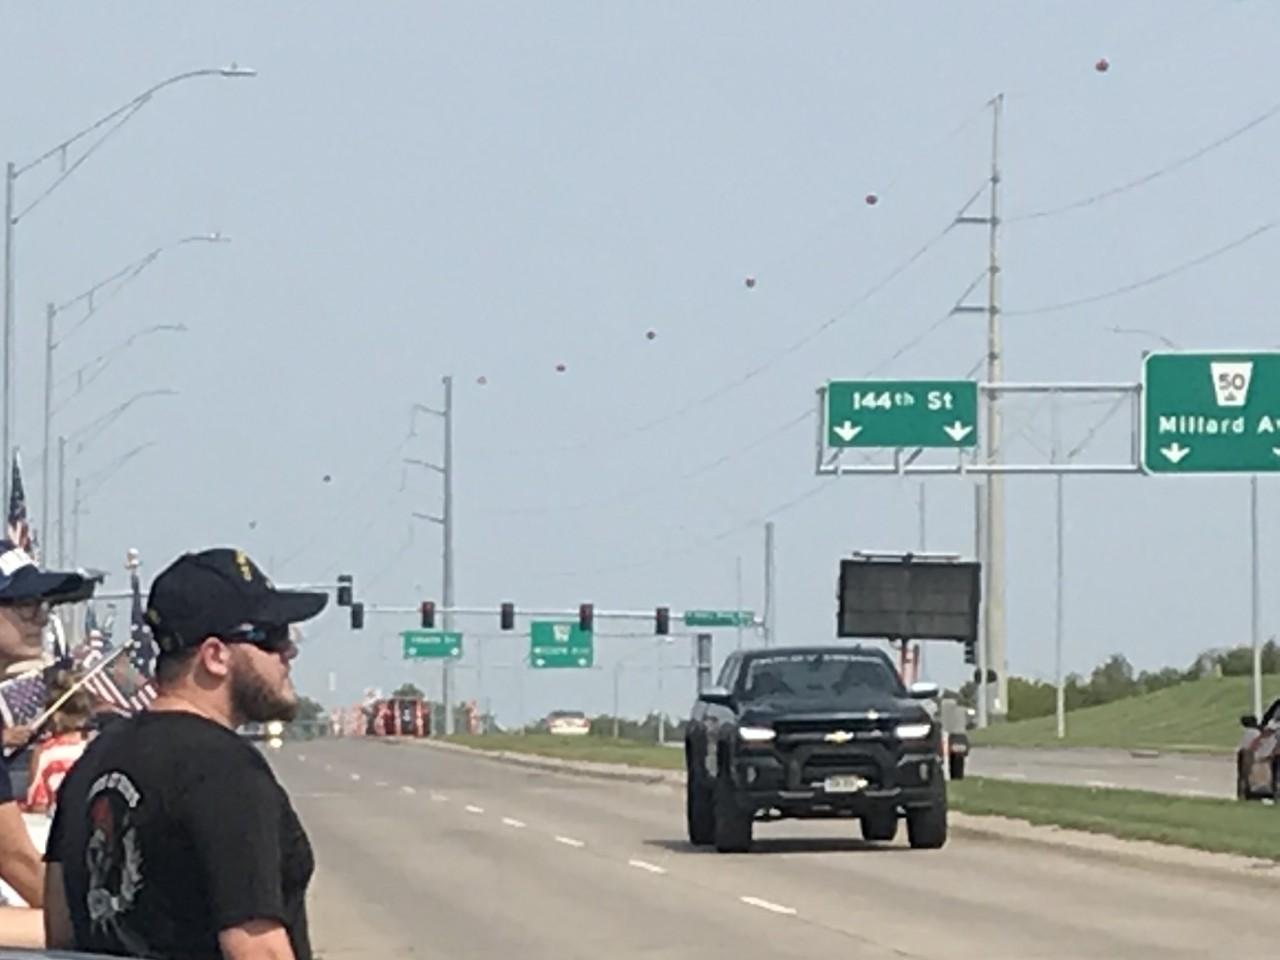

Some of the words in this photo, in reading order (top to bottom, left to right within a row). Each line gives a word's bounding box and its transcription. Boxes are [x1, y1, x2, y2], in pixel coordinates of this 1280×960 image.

[1218, 373, 1246, 391] 50
[852, 391, 916, 411] 144th
[927, 390, 954, 411] St
[1159, 415, 1245, 434] Millard
